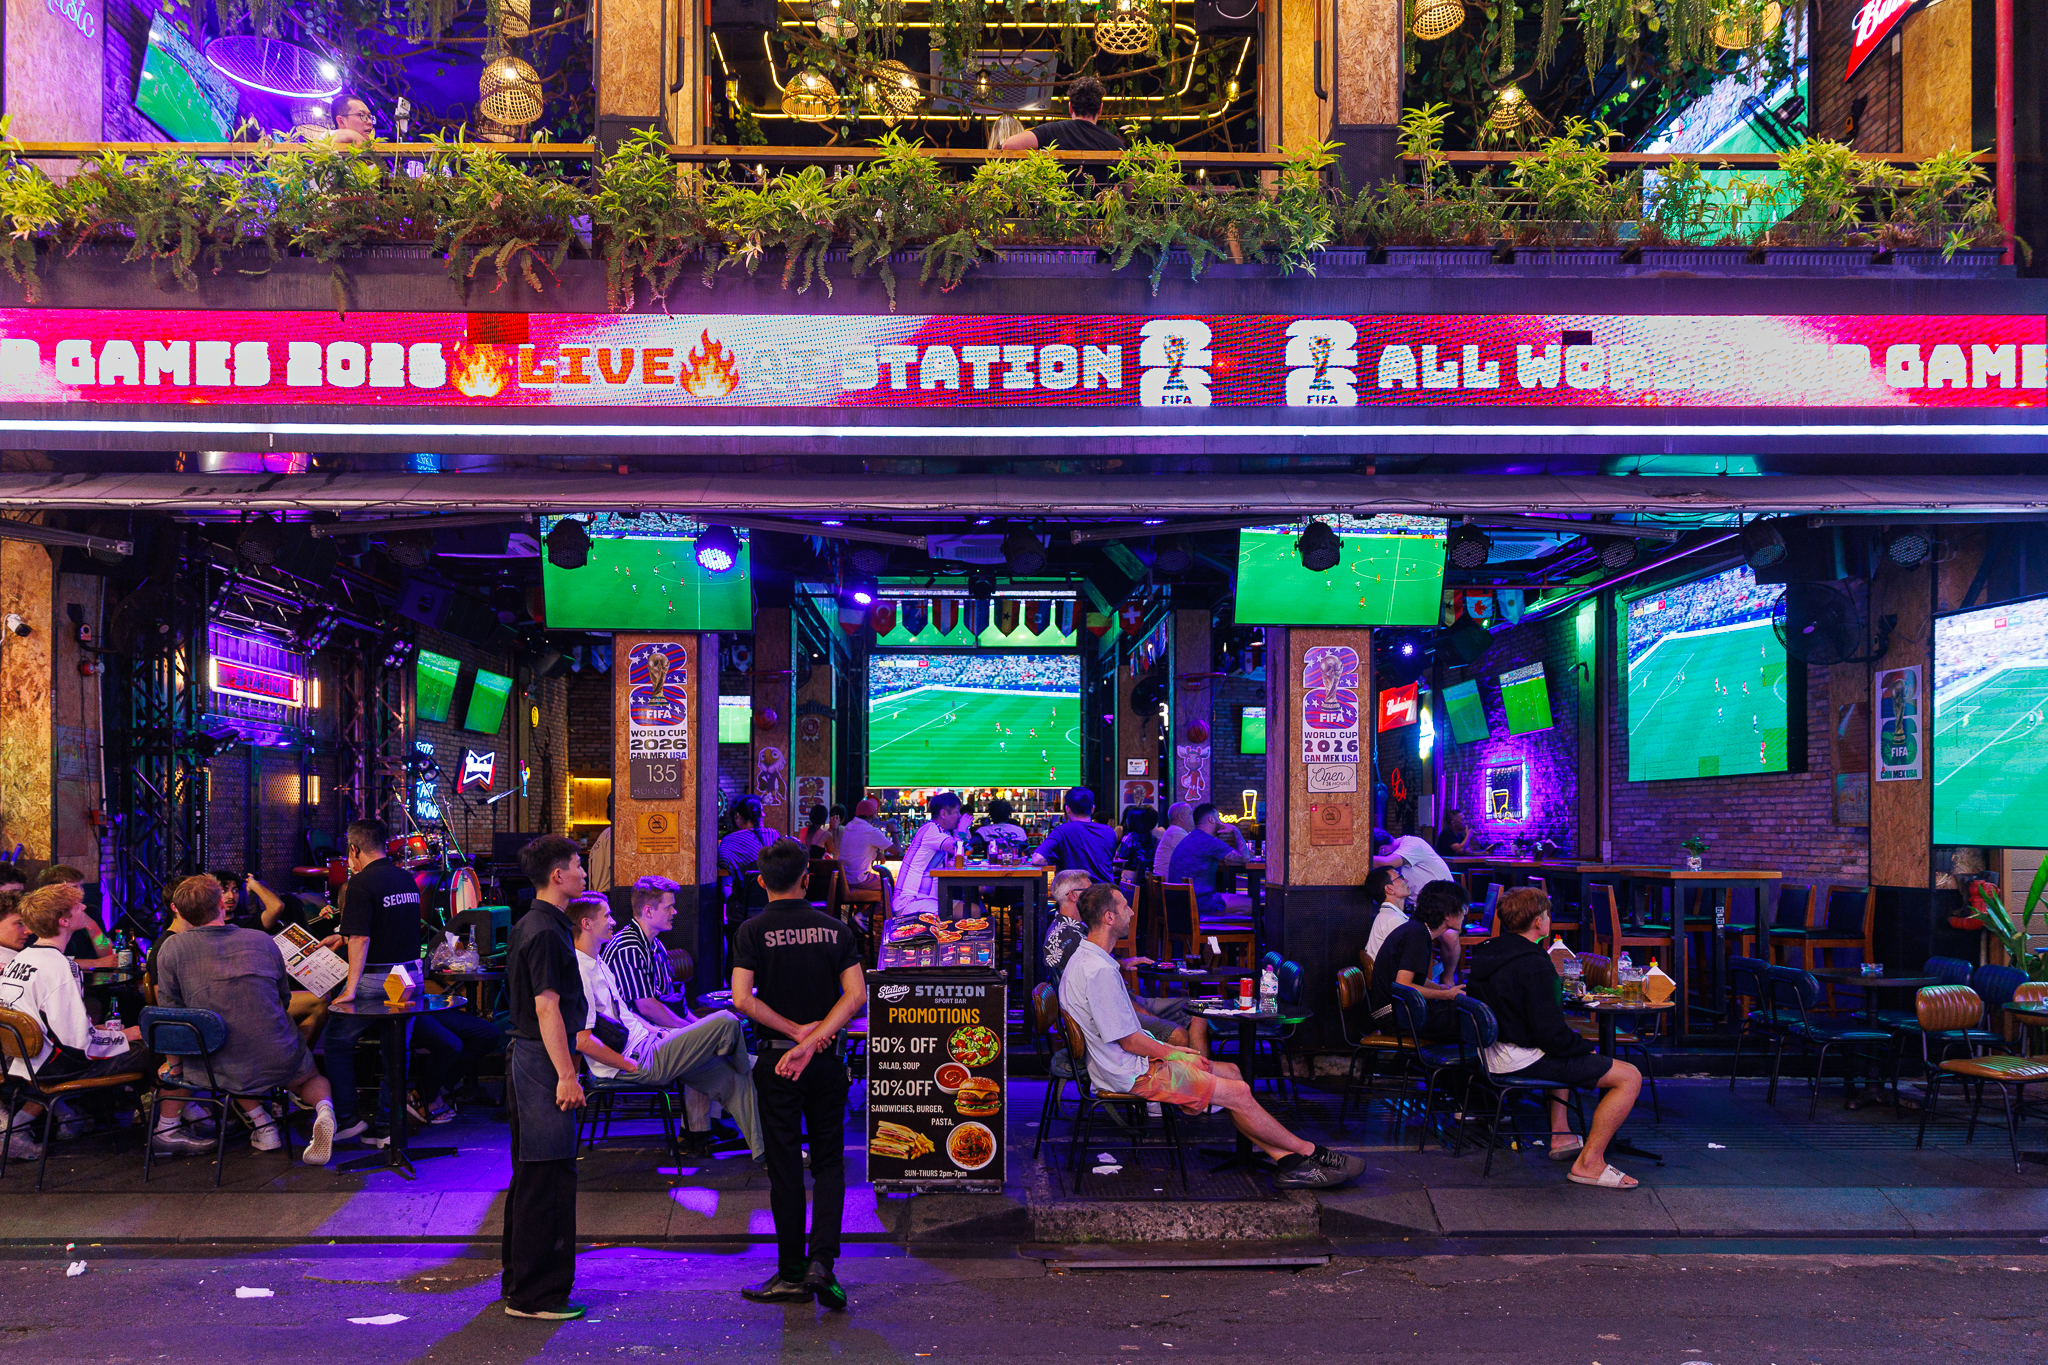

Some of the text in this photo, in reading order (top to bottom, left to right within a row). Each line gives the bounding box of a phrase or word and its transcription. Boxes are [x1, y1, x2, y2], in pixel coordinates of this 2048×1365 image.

[56, 339, 271, 386] GAMES
[518, 345, 677, 389] LIVE
[842, 345, 1122, 389] STATION
[1377, 344, 1500, 389] ALL
[1161, 395, 1192, 405] FIFA
[1307, 395, 1338, 405] FIFA
[646, 709, 672, 719] FIFA
[1320, 713, 1345, 722] FIFA
[667, 729, 687, 737] CUP
[630, 739, 687, 750] 2026
[1304, 740, 1358, 752] 2026
[1891, 746, 1908, 758] FIFA
[1304, 754, 1321, 762] CAN
[1341, 754, 1358, 762] USA
[646, 764, 677, 782] 135
[1311, 767, 1346, 785] Open
[1880, 769, 1917, 780] CAN MEX USA
[764, 927, 838, 947] SECURITY
[878, 984, 910, 999] Station
[915, 985, 986, 997] STATION
[888, 1007, 980, 1024] PROMOTIONS
[871, 1036, 938, 1053] 50% OFF
[878, 1061, 920, 1070] SALAD, SOUP
[870, 1104, 944, 1113] SANDWICHES, BURGER,
[931, 1118, 954, 1126] PASTA.
[904, 1169, 967, 1178] SUN-THURS 2pm-7pm
